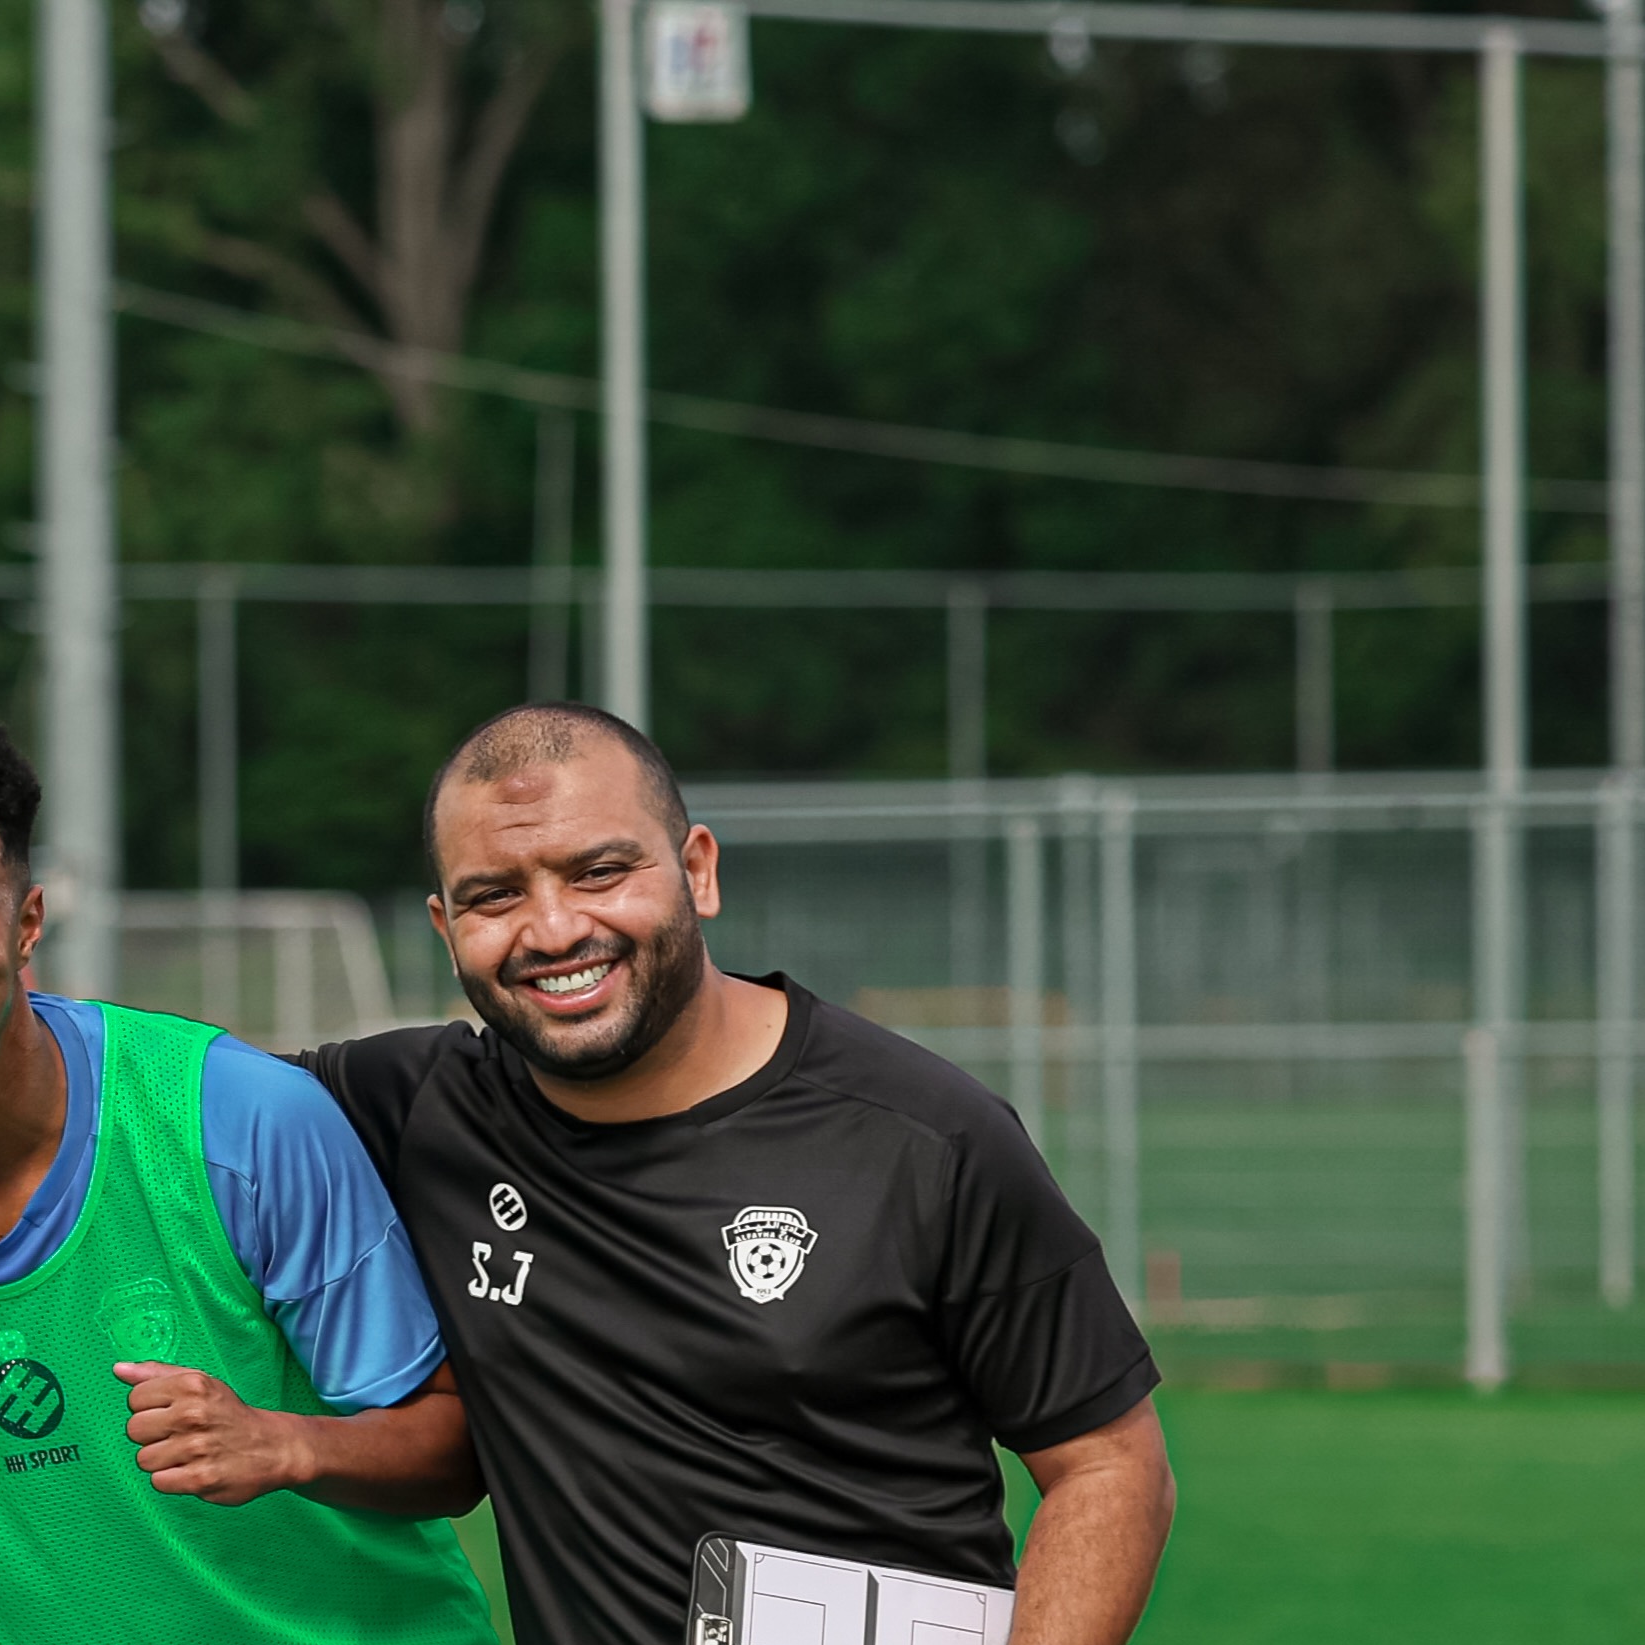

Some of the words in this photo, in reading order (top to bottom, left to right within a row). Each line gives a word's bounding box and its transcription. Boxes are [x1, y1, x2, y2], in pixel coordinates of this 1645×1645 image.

[778, 1234, 802, 1246] CLUB
[4, 1454, 28, 1473] HH
[29, 1445, 82, 1470] SPORT
